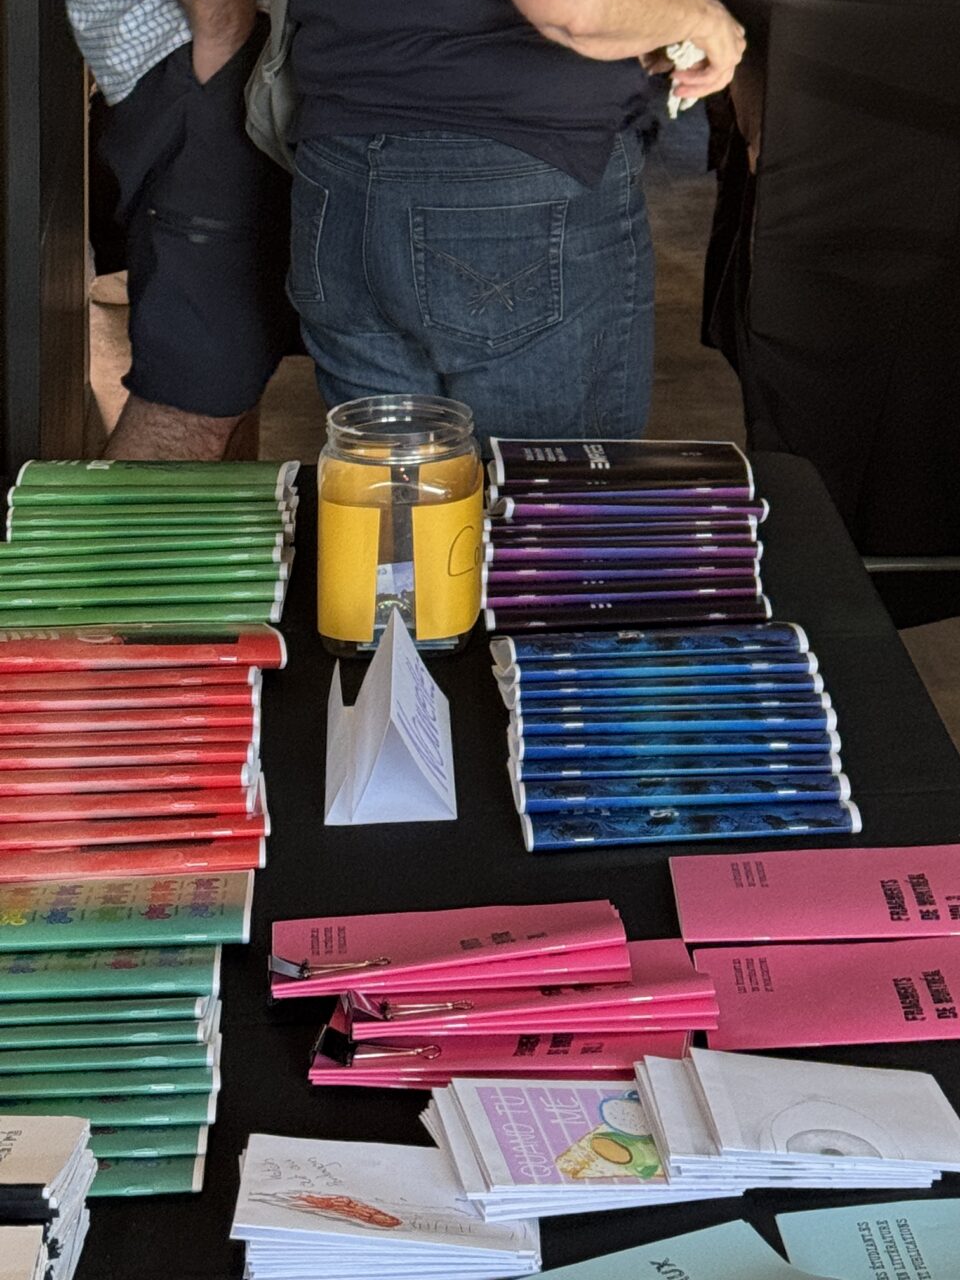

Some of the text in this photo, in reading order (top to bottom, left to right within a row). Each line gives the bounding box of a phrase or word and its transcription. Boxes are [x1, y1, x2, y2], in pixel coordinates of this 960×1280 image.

[490, 1095, 528, 1116] TU
[539, 1096, 586, 1125] ME
[502, 1123, 552, 1178] QUAND
[876, 1220, 906, 1271] LITTÉRATURE
[896, 1218, 927, 1271] PUBLICATIONS
